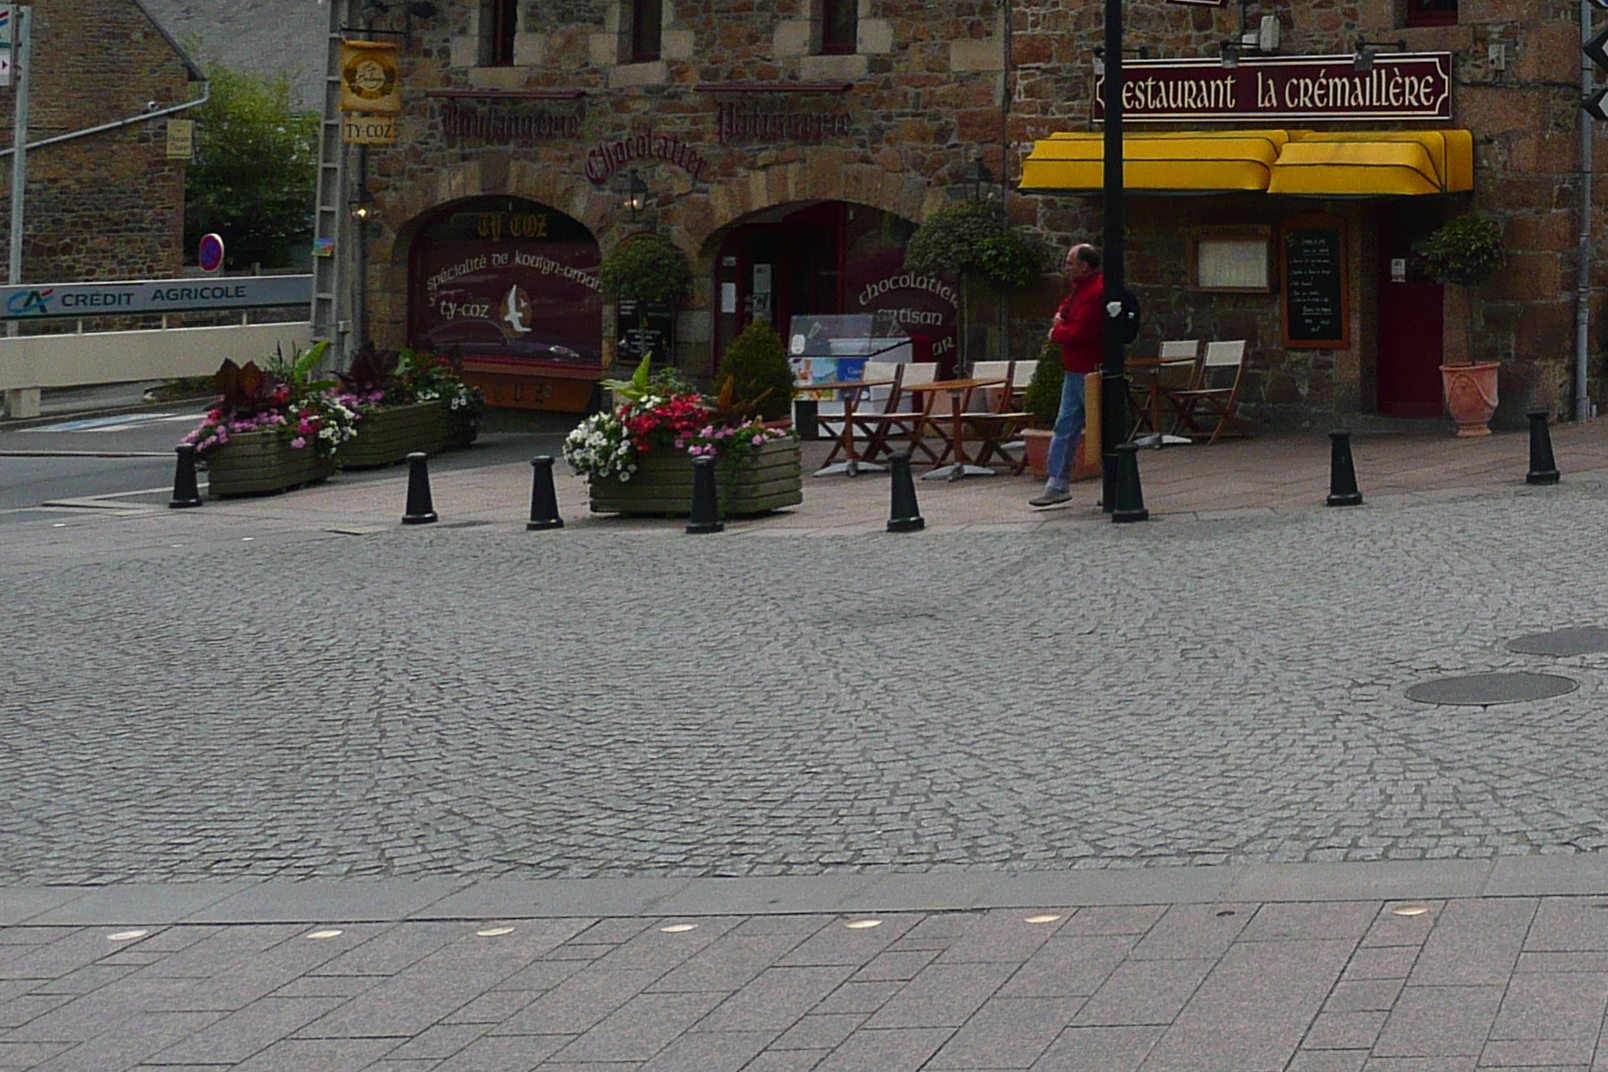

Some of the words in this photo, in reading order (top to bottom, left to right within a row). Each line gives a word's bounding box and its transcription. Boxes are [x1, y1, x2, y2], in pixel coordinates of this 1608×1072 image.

[1121, 75, 1237, 110] estaurant
[1284, 67, 1435, 108] crémaillère
[586, 124, 708, 185] Chocolatier
[61, 289, 134, 307] CRÉDIT
[151, 285, 247, 301] AGRICOLE
[441, 299, 490, 321] ty-coz
